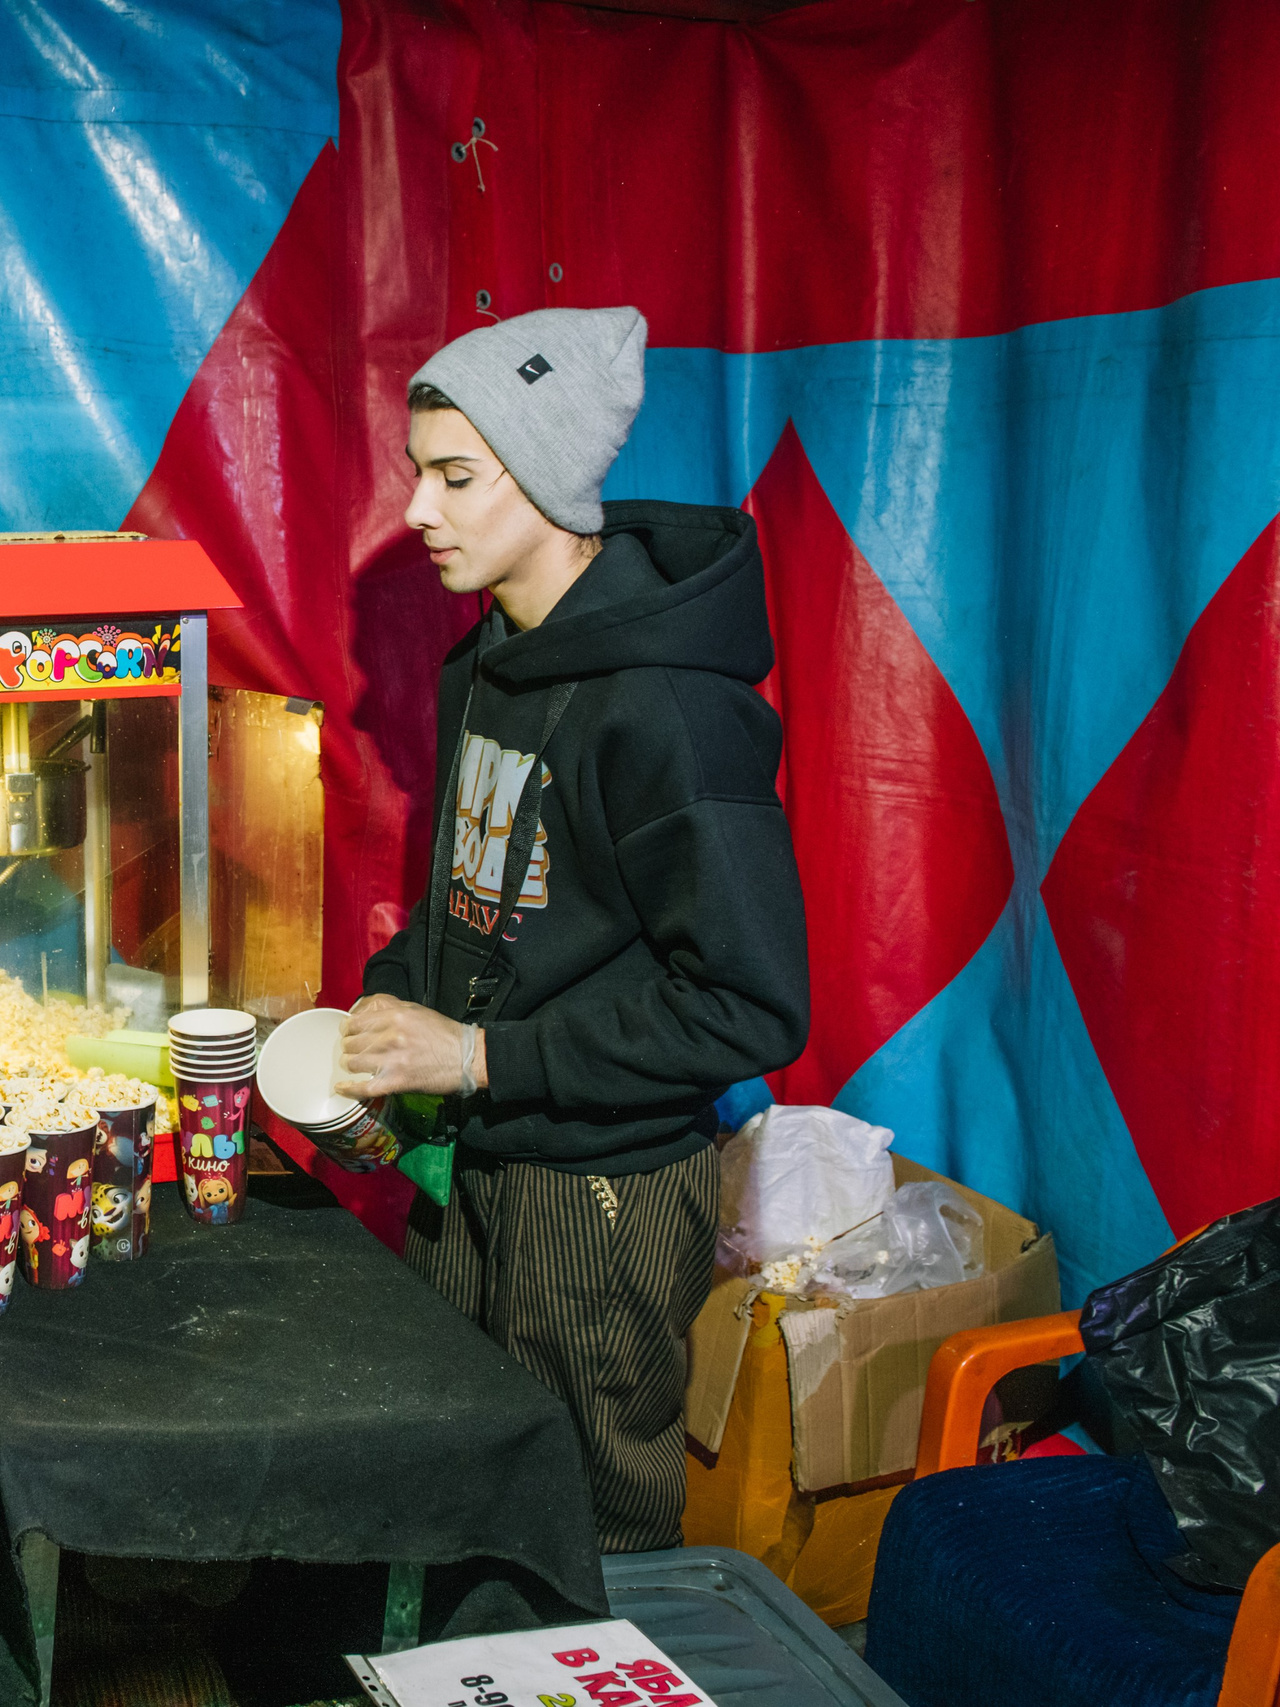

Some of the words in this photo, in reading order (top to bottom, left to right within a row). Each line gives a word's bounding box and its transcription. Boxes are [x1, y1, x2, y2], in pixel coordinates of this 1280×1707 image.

[551, 1647, 600, 1668] В
[460, 1674, 515, 1707] 8-9
[573, 1670, 647, 1707] КА
